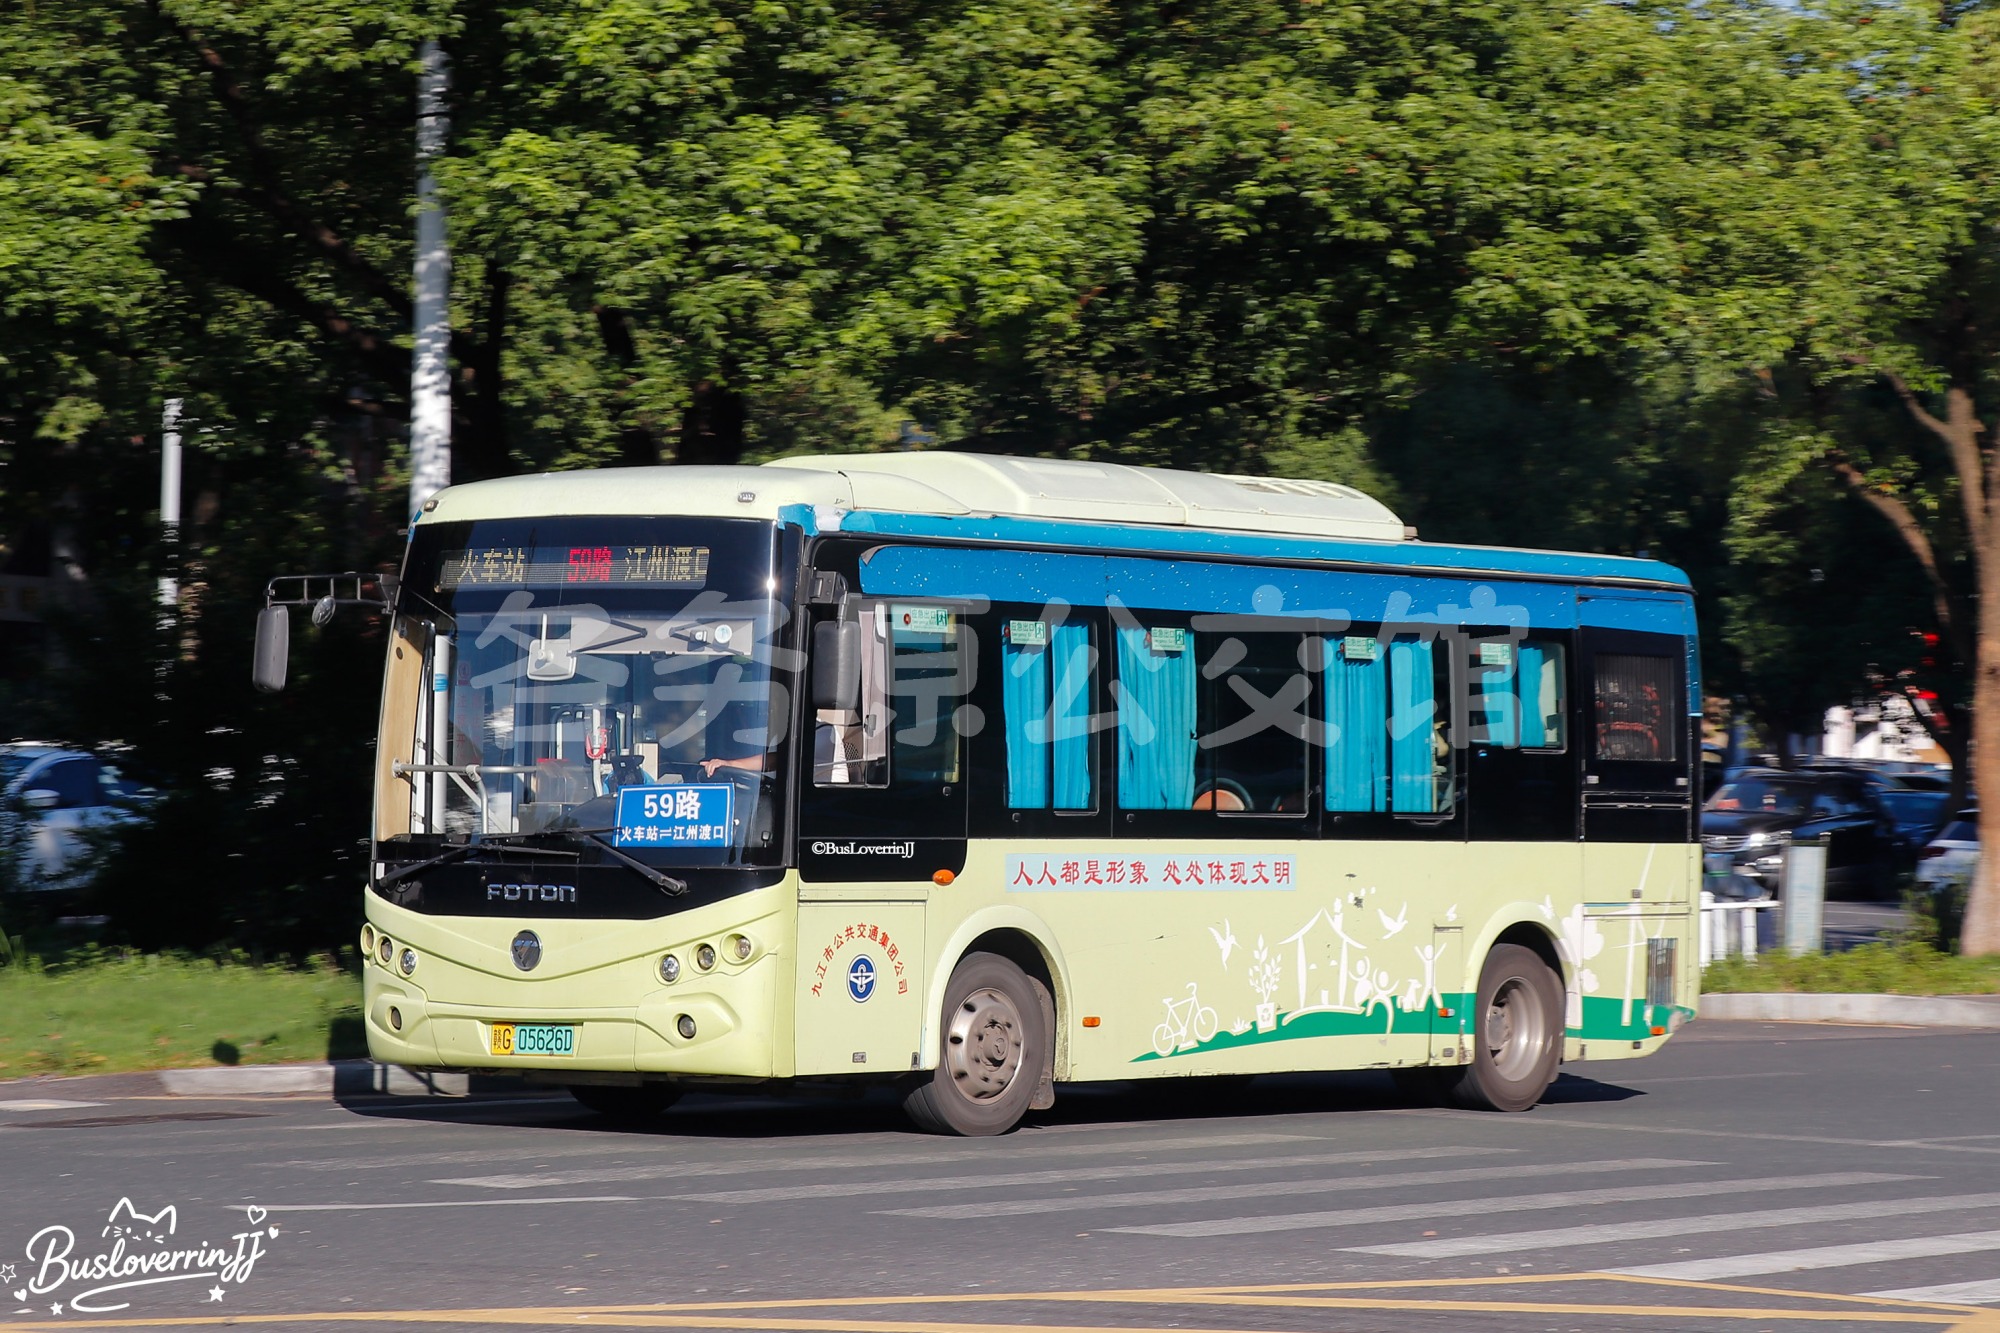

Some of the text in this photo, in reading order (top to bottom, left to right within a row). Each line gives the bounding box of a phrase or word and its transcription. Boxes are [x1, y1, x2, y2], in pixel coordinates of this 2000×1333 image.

[457, 546, 710, 582] 火车站 59路 江州渡口
[644, 790, 701, 820] 59路
[1012, 860, 1290, 886] 人人都是形象 处处体现文明
[487, 884, 576, 902] FOTON
[811, 922, 908, 997] 九江市公共交通集团公司
